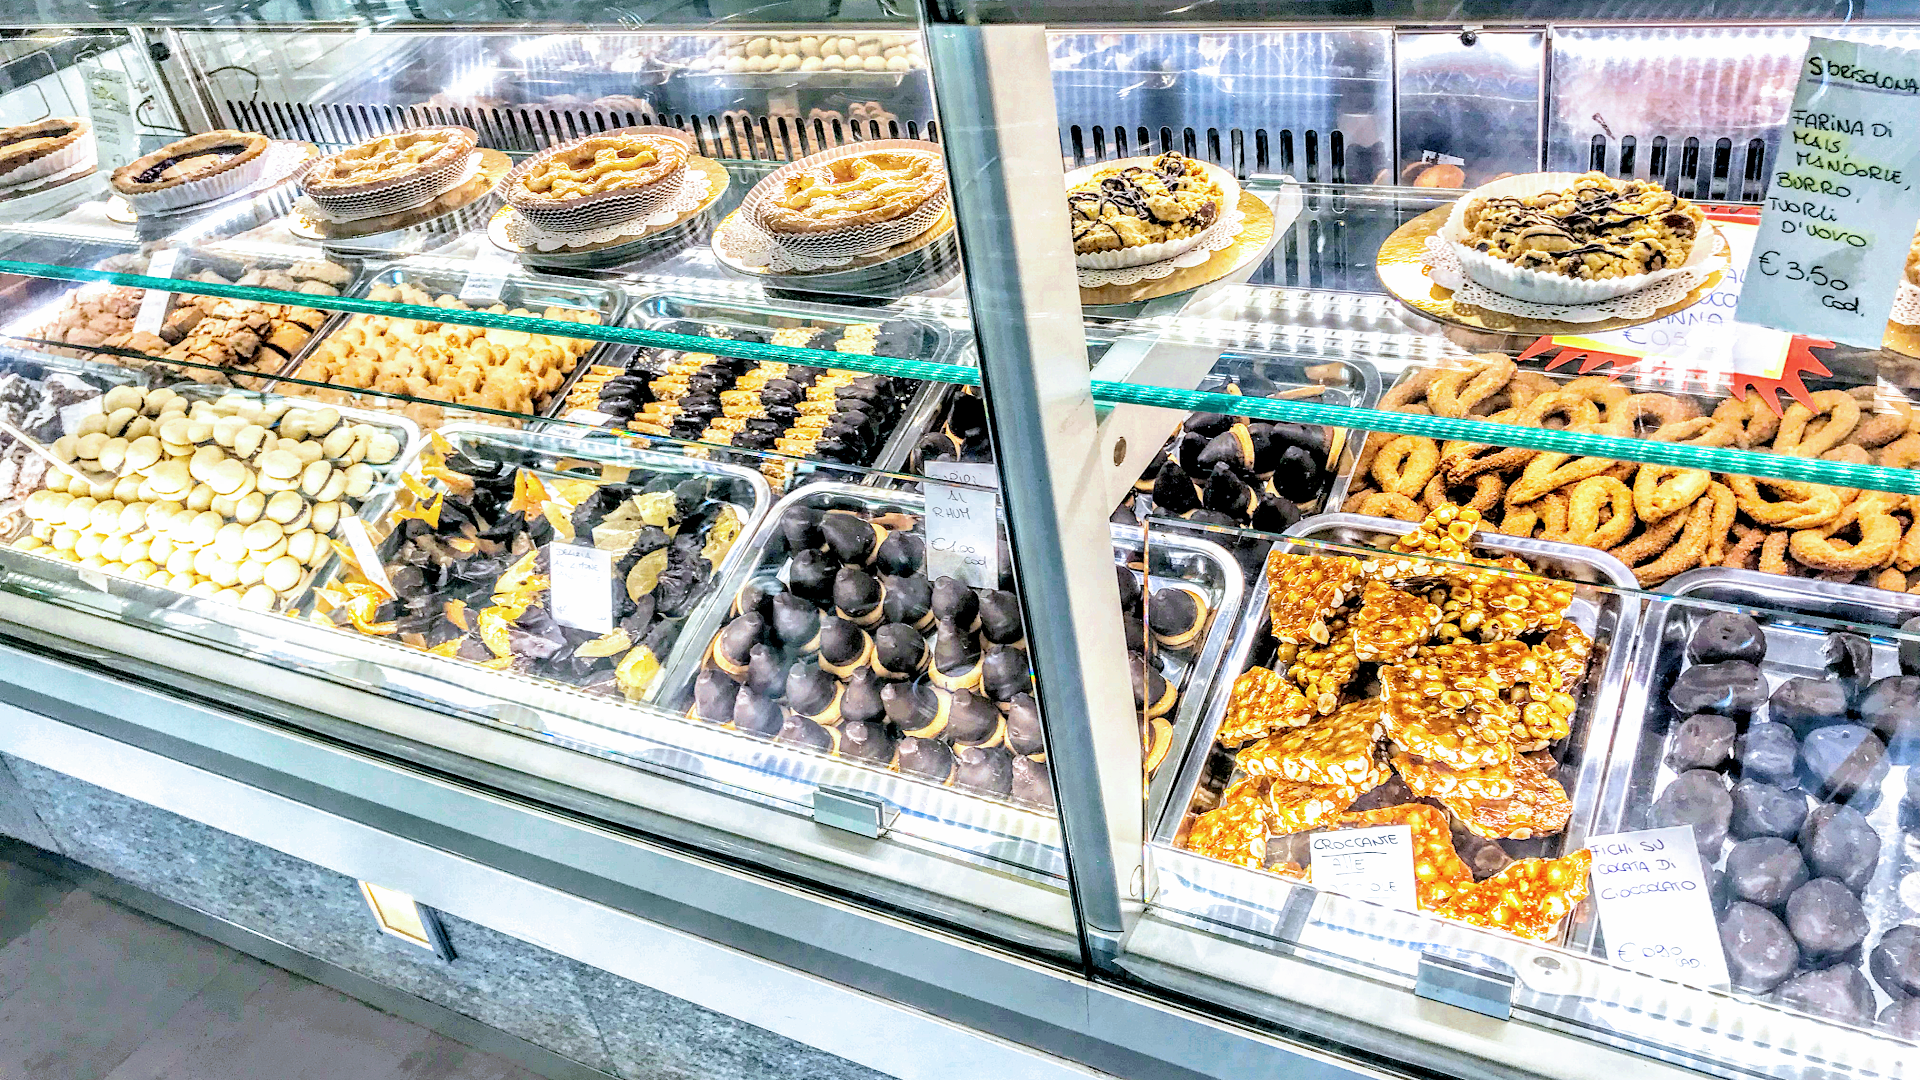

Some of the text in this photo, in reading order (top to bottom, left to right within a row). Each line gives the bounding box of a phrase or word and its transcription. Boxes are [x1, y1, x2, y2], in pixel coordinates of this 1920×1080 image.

[932, 506, 971, 519] RHUM
[1313, 834, 1399, 850] CROCCANTE
[1640, 838, 1665, 853] SU
